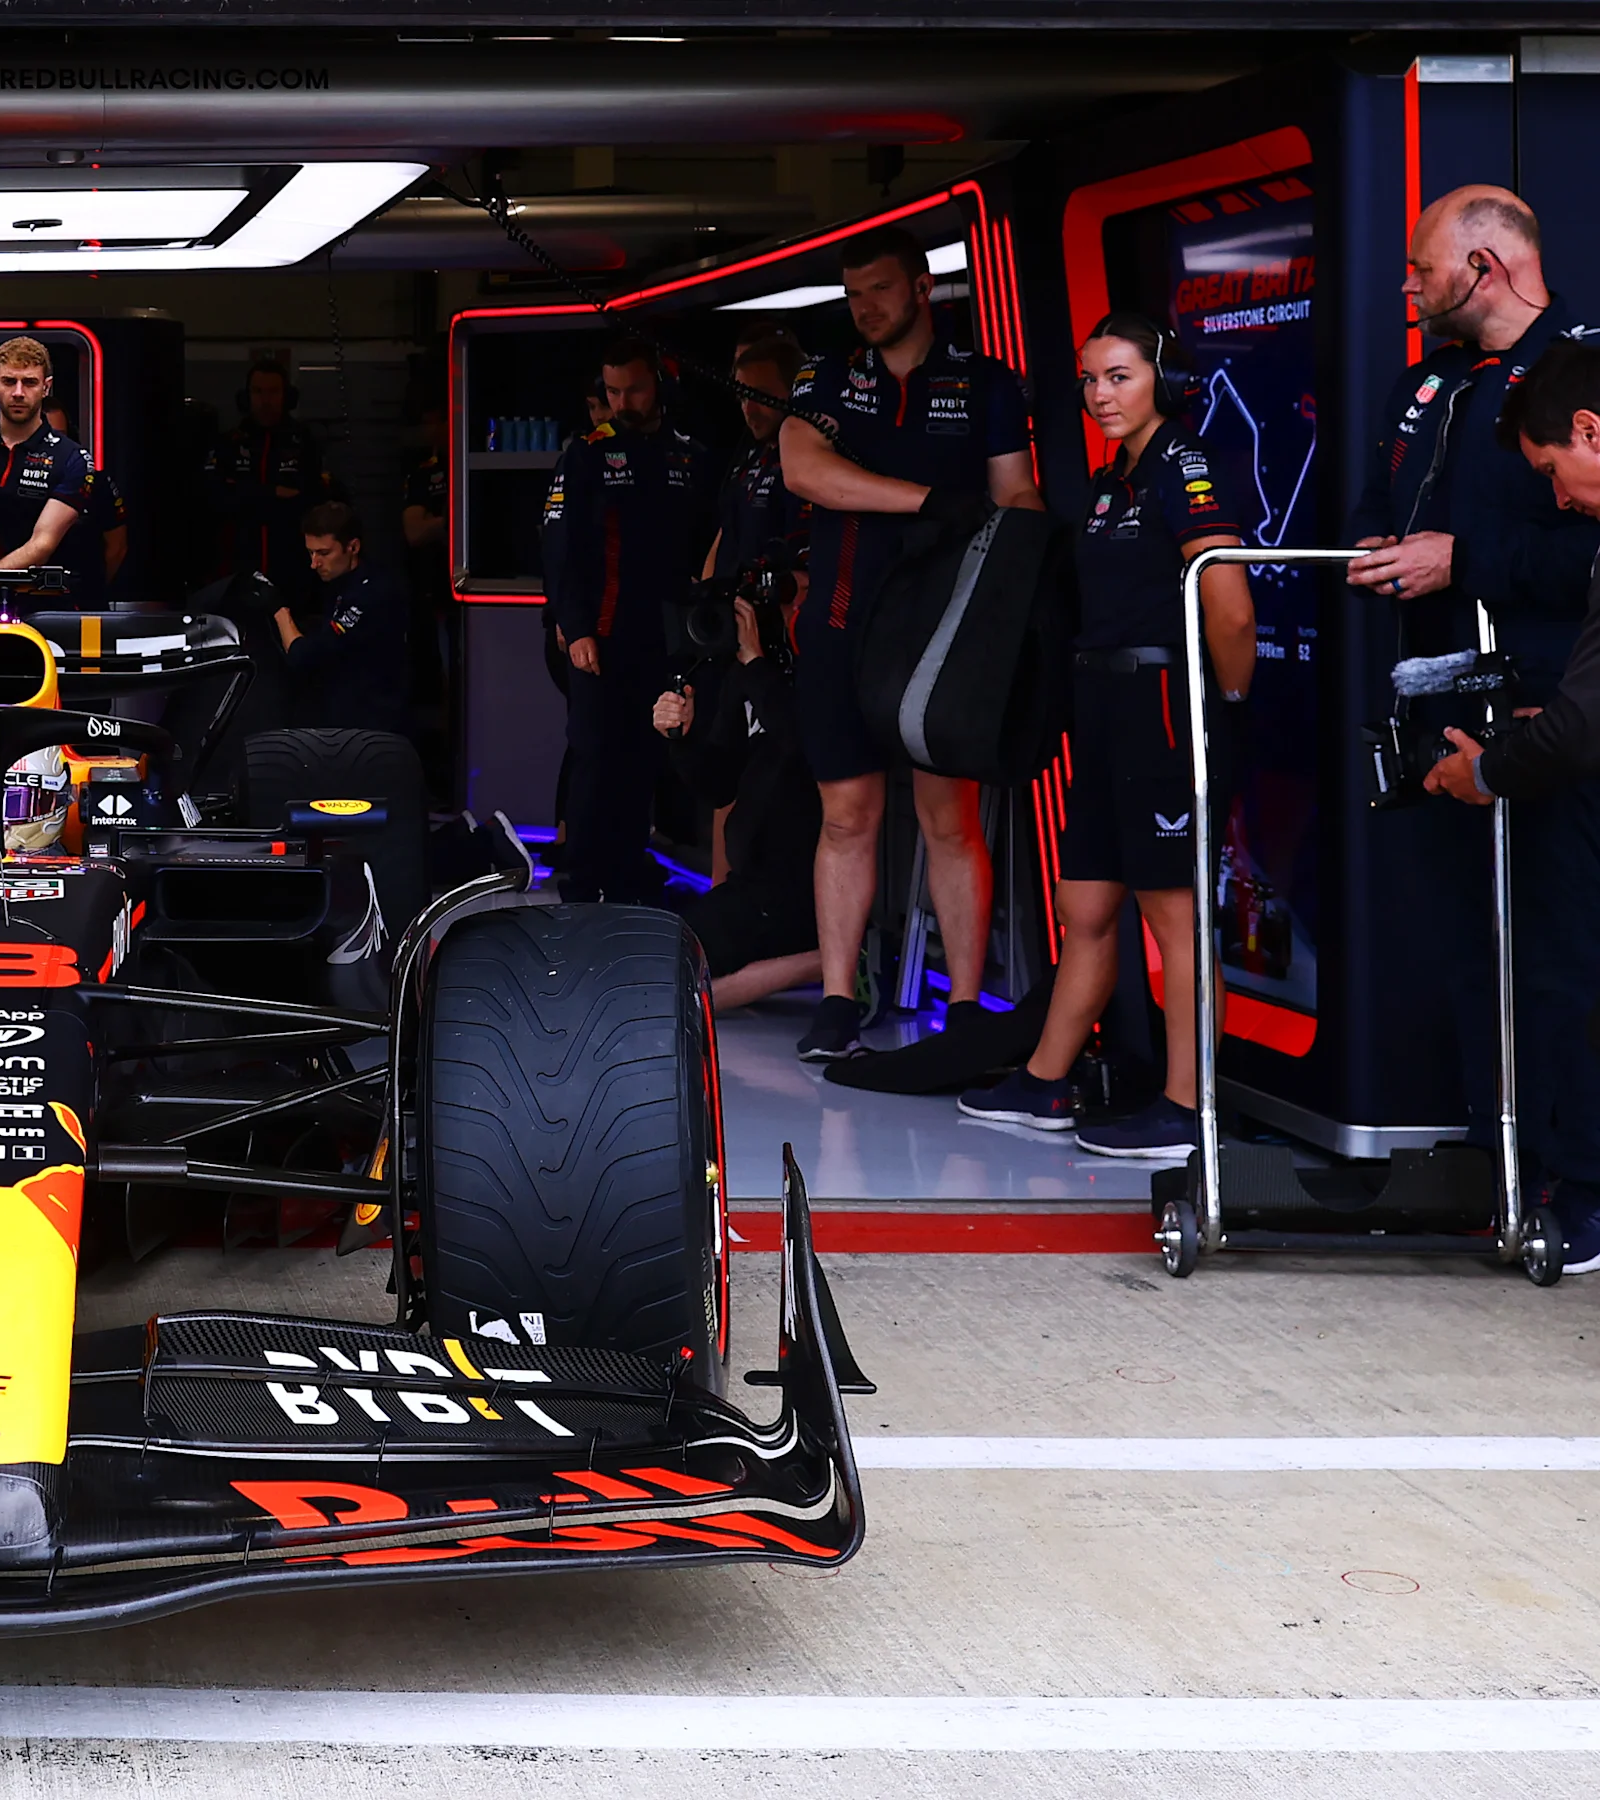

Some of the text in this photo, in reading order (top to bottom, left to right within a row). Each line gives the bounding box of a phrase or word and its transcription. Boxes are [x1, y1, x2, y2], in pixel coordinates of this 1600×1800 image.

[0, 68, 330, 90] REDBULLRACING.COM
[1175, 270, 1250, 315] GREAT
[1203, 299, 1312, 334] SILVERSTONE CIRCUIT
[930, 397, 968, 409] BYBIT
[22, 468, 50, 481] BYBIT
[19, 479, 49, 489] HONDA
[102, 721, 121, 738] Sui
[91, 816, 138, 827] inter.mx
